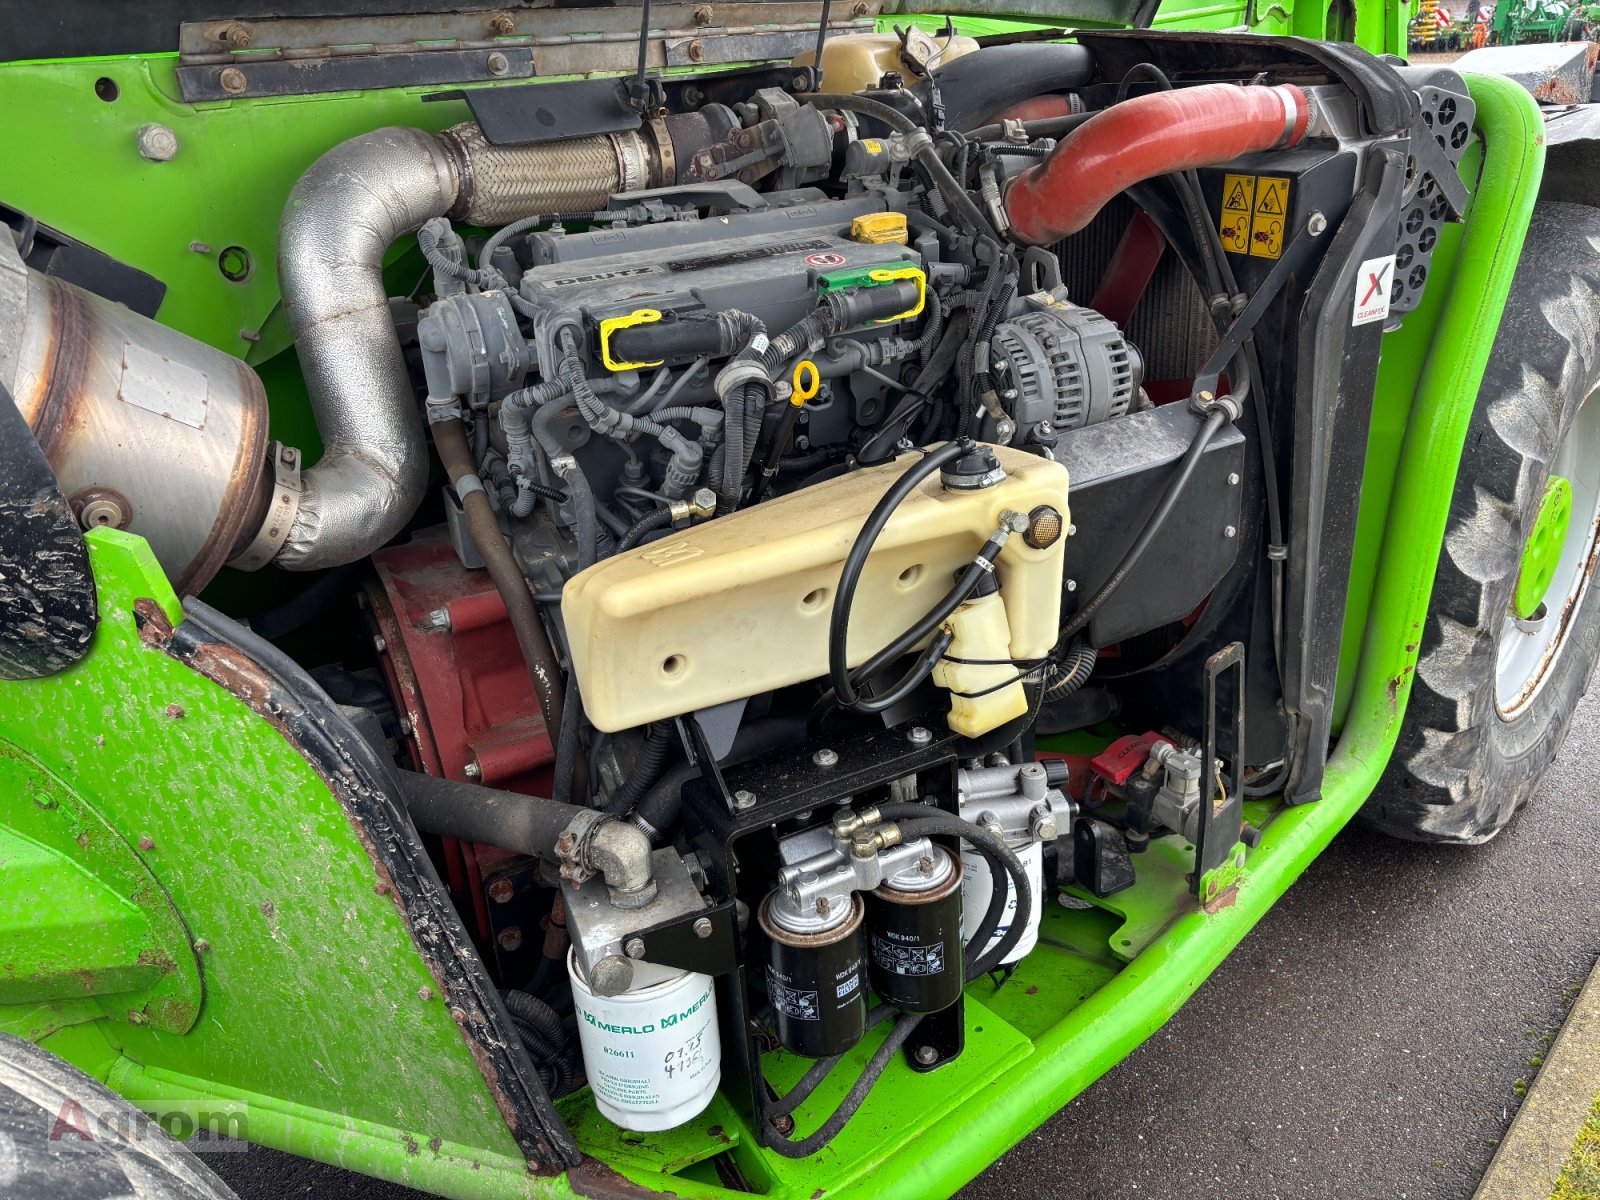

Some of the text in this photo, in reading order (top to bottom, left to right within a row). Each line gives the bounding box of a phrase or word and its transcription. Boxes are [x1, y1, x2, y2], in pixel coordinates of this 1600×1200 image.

[555, 267, 654, 285] DEUTZ
[887, 930, 900, 940] WDK
[835, 969, 848, 981] WDK
[598, 1021, 655, 1034] MERLO
[603, 1046, 635, 1059] 026611
